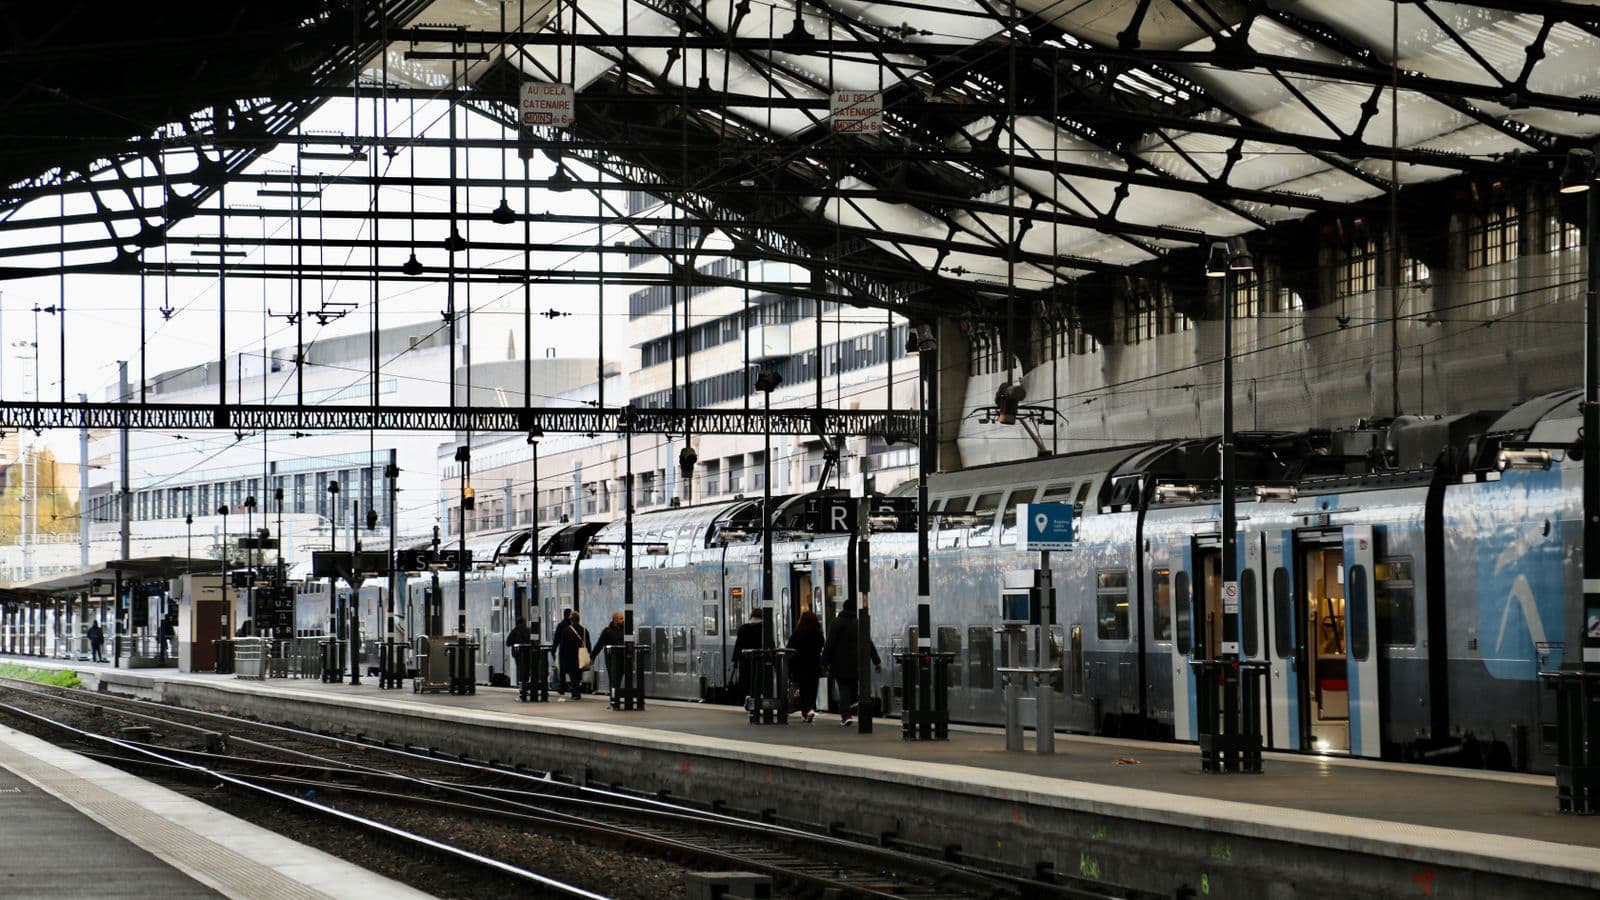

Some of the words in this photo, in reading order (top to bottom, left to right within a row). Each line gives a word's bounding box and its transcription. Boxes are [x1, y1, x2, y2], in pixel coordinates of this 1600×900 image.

[527, 85, 539, 95] AU
[543, 86, 567, 96] DELA
[837, 94, 848, 103] AU
[523, 99, 570, 110] CATENAIRE
[525, 113, 551, 122] MOINS
[831, 505, 849, 531] R
[415, 554, 426, 570] S
